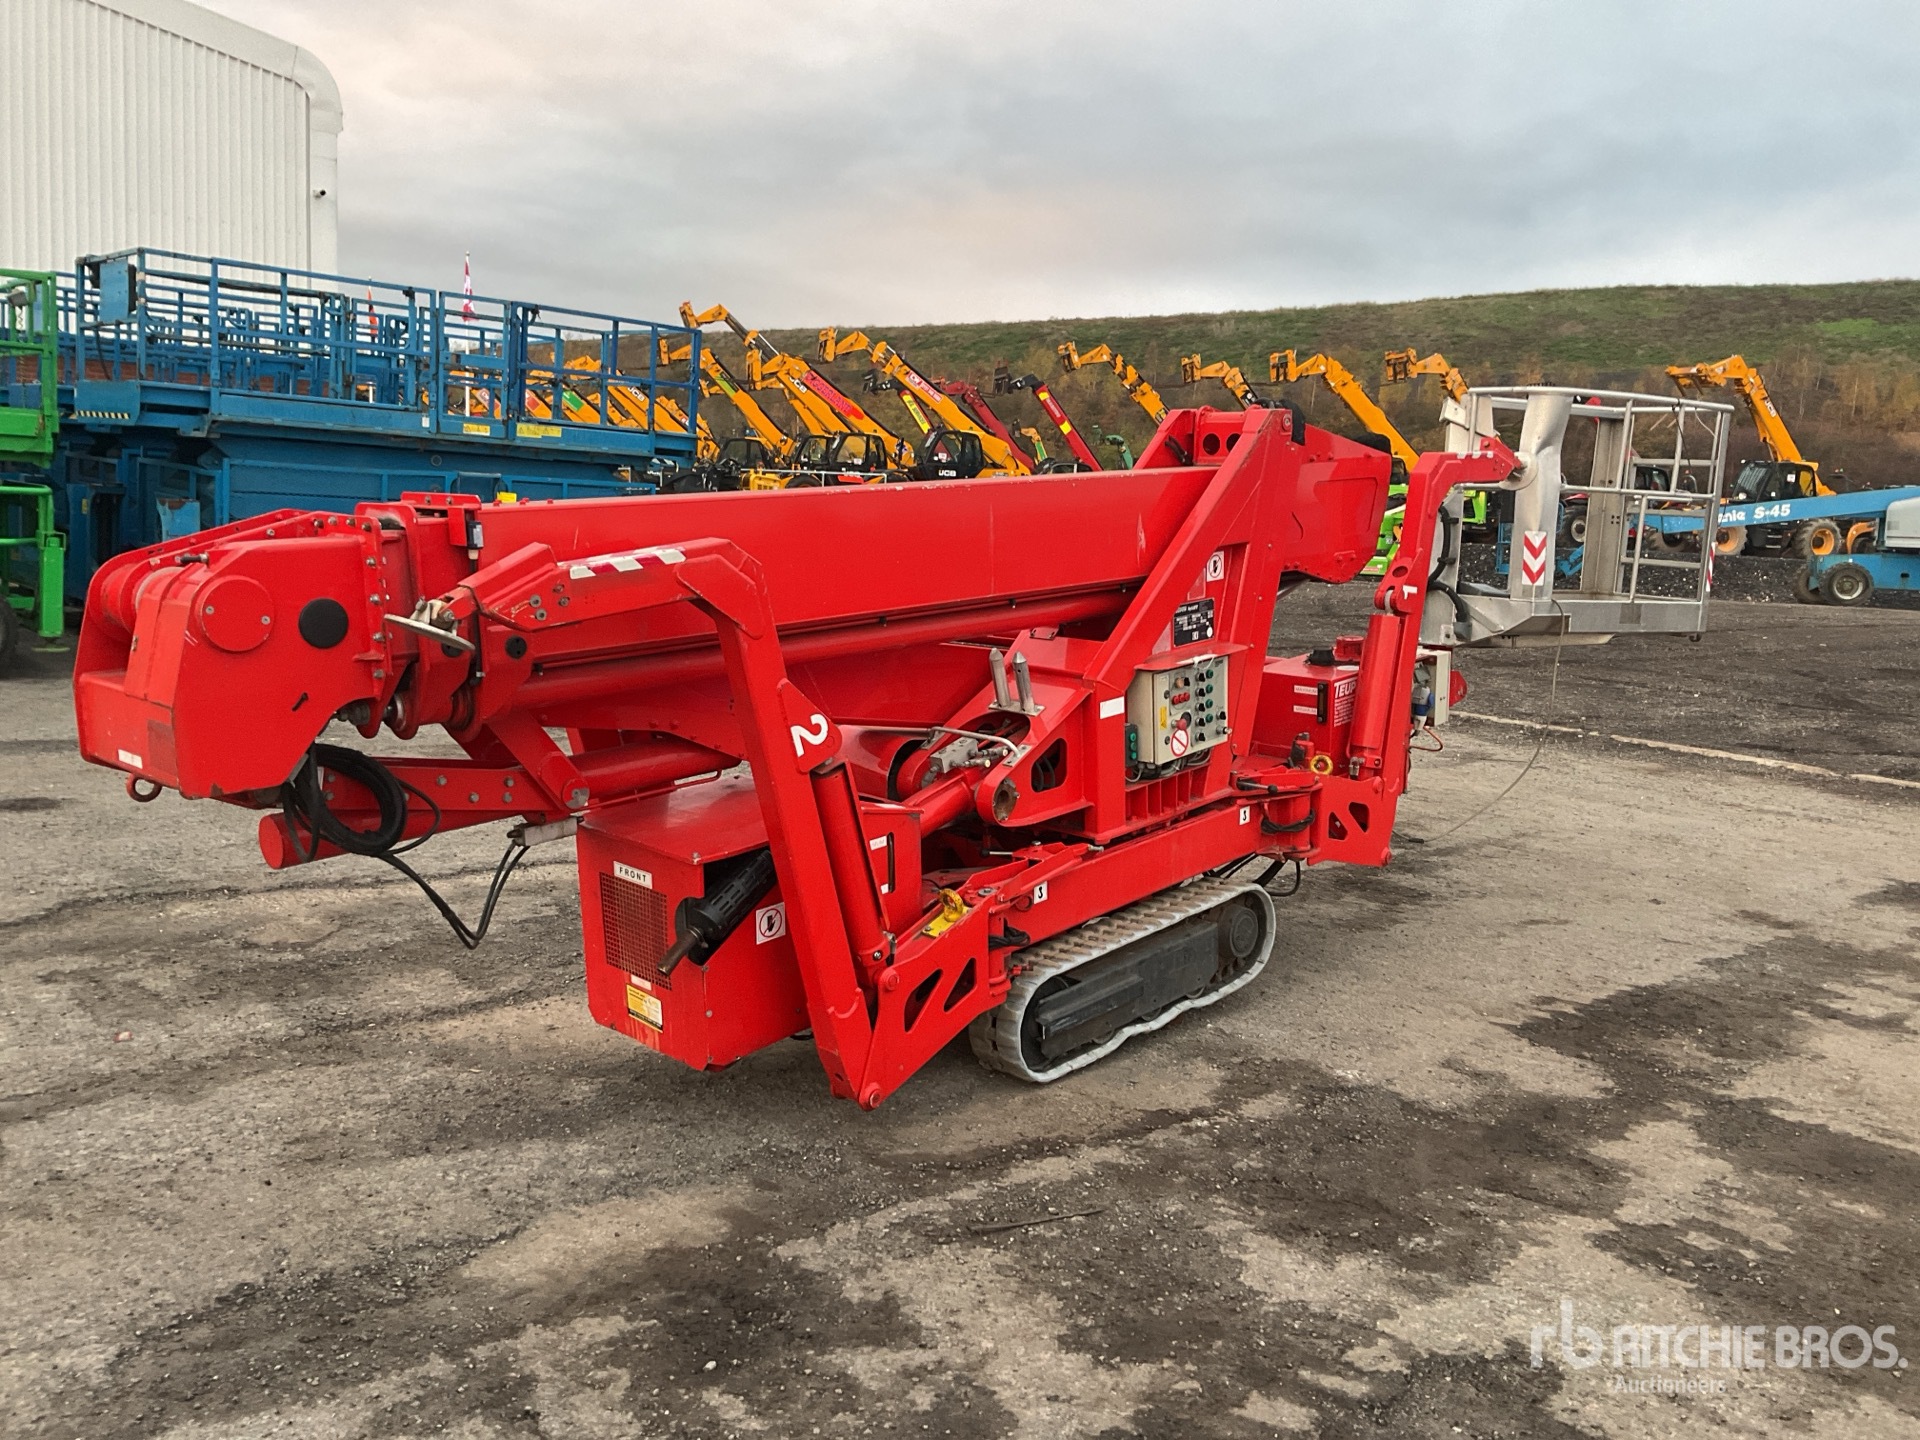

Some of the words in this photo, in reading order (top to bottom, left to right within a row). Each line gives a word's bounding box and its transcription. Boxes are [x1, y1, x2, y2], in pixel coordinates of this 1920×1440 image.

[627, 385, 646, 402] JCB
[789, 376, 808, 394] JCB
[1764, 399, 1777, 417] JCB
[938, 469, 957, 477] JCB
[1753, 503, 1791, 519] S-45
[1402, 584, 1418, 600] 1
[1333, 676, 1358, 699] TEUP
[790, 713, 829, 758] 2
[619, 866, 647, 883] FRONT
